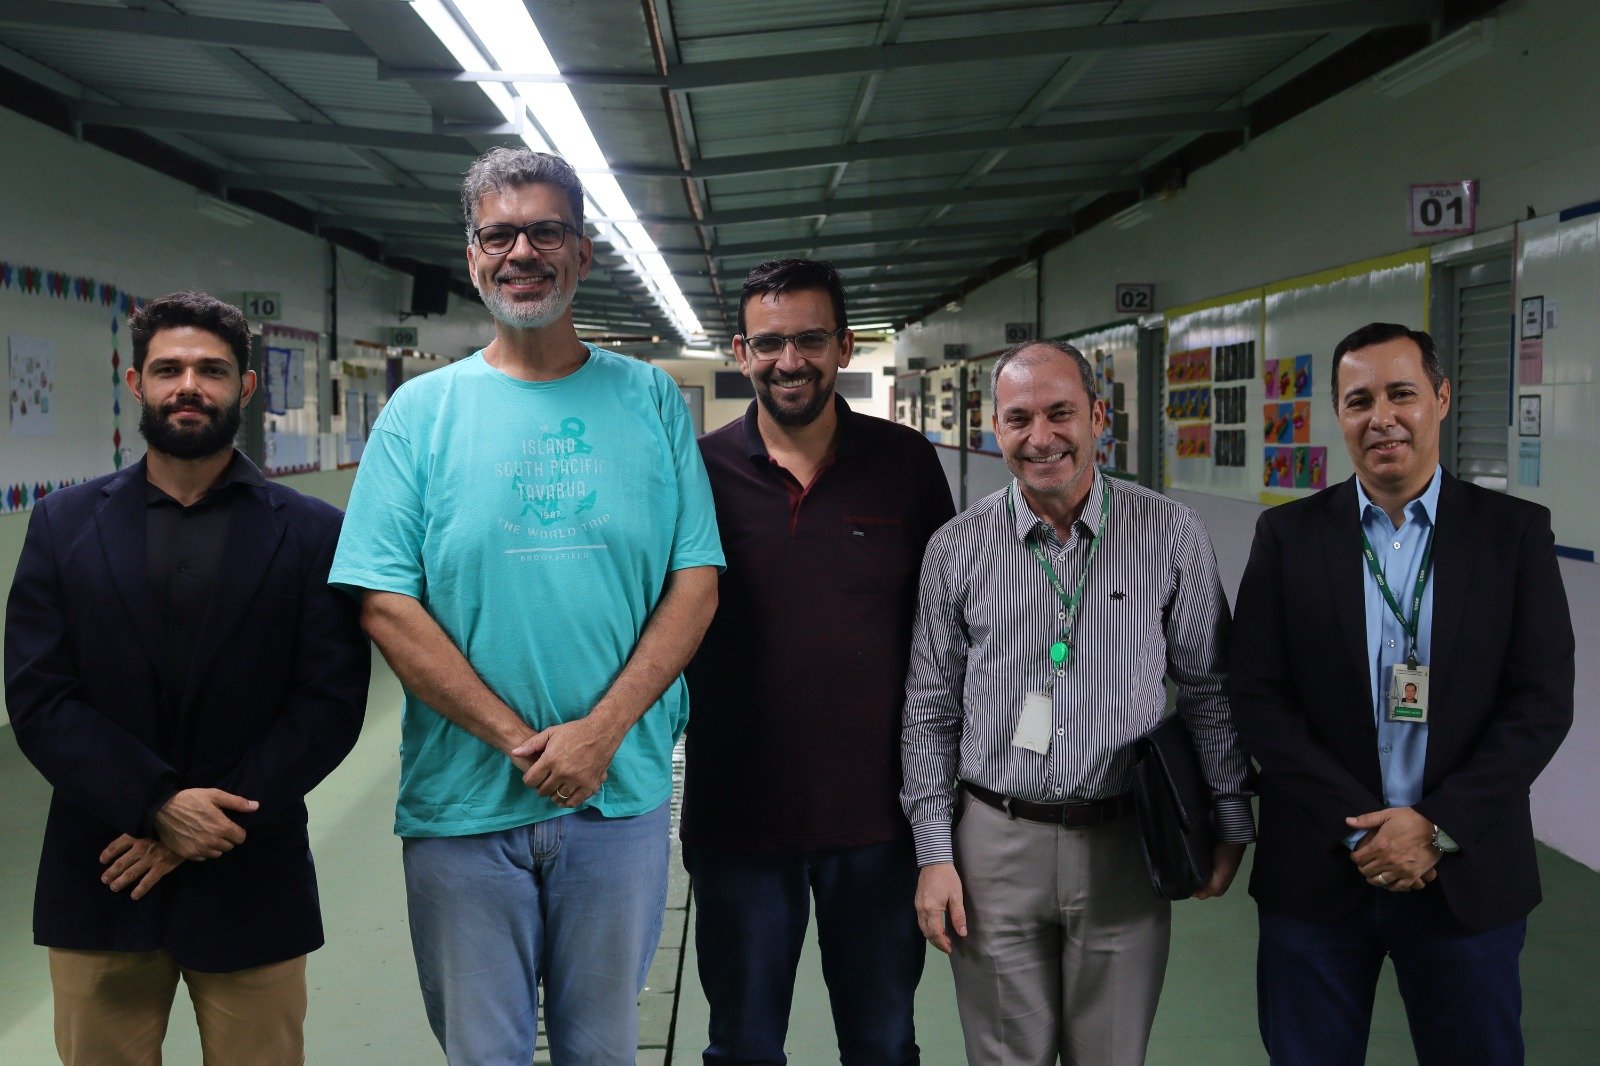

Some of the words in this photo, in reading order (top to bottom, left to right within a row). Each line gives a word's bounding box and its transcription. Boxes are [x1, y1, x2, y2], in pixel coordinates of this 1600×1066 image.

[1420, 197, 1463, 227] 01
[251, 299, 275, 315] 10
[1121, 291, 1149, 308] 02
[394, 332, 413, 344] 09
[1009, 328, 1027, 340] 03
[522, 437, 576, 455] ISLAND
[494, 460, 544, 478] SOUTH
[551, 458, 606, 475] PACIFIC
[517, 480, 586, 501] TAVARUA
[498, 518, 521, 535] THE
[528, 527, 576, 539] WORLD
[581, 513, 610, 532] TRIP
